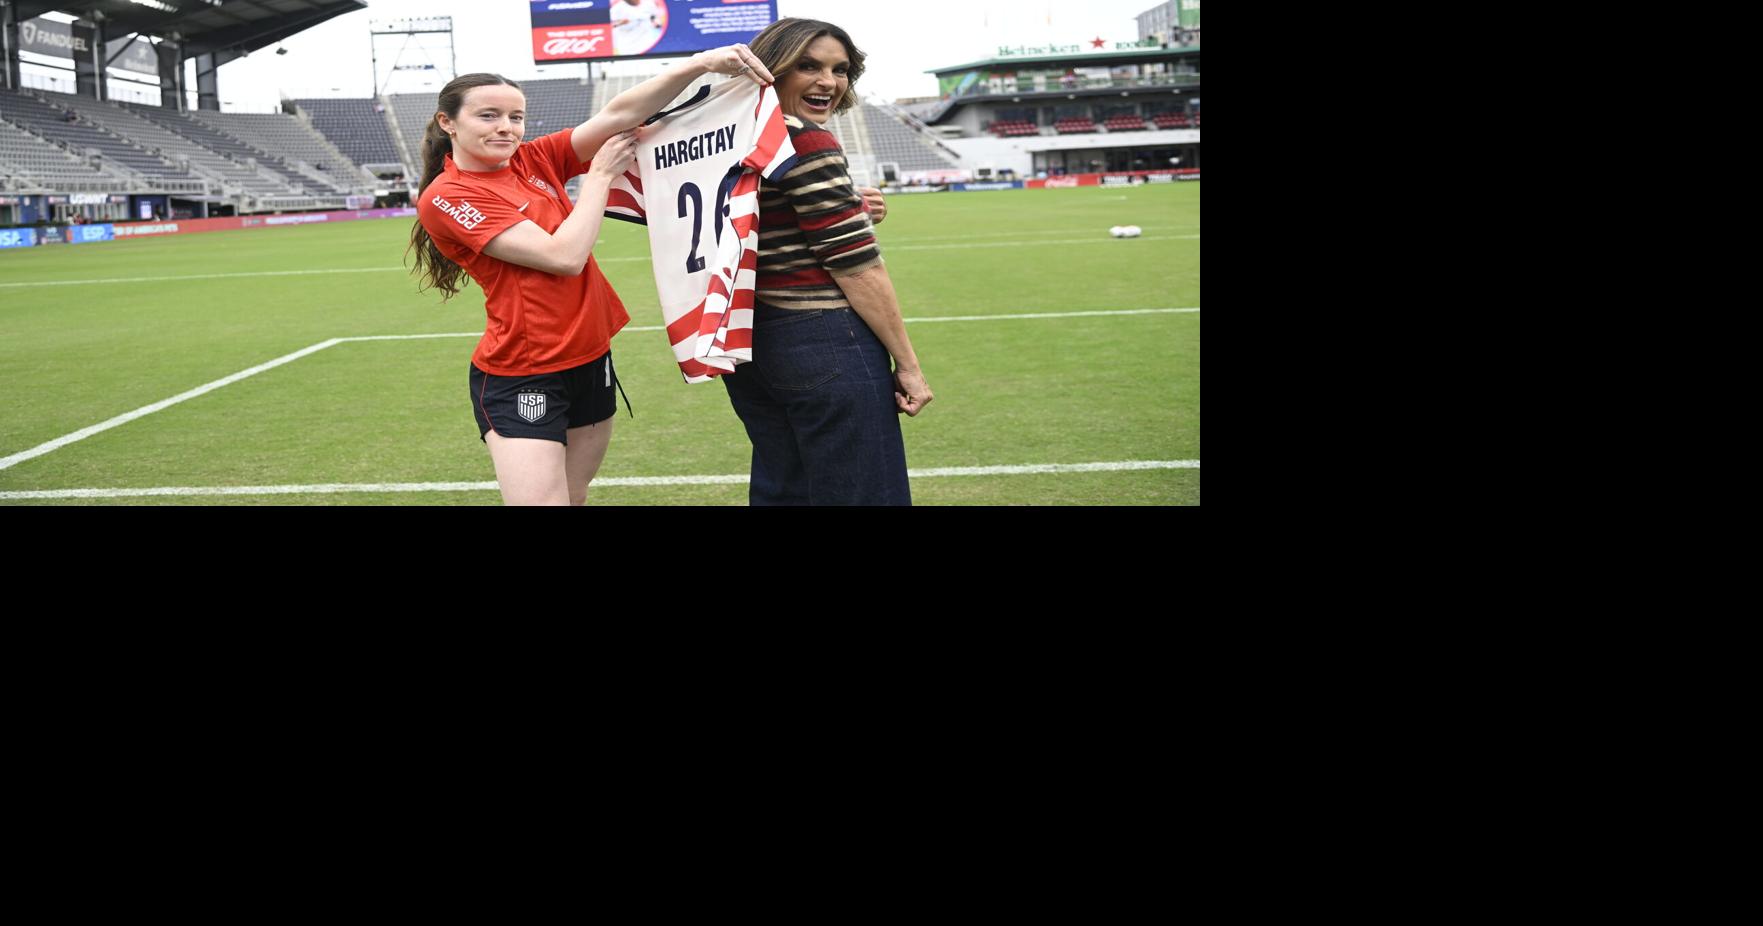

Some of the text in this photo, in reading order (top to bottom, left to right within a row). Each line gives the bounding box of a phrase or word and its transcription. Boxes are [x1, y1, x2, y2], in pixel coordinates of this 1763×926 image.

[36, 30, 89, 52] FANDUEL
[998, 42, 1080, 56] Heineken
[654, 123, 737, 171] HARGITAY
[431, 194, 478, 231] POWER
[520, 395, 544, 406] USA
